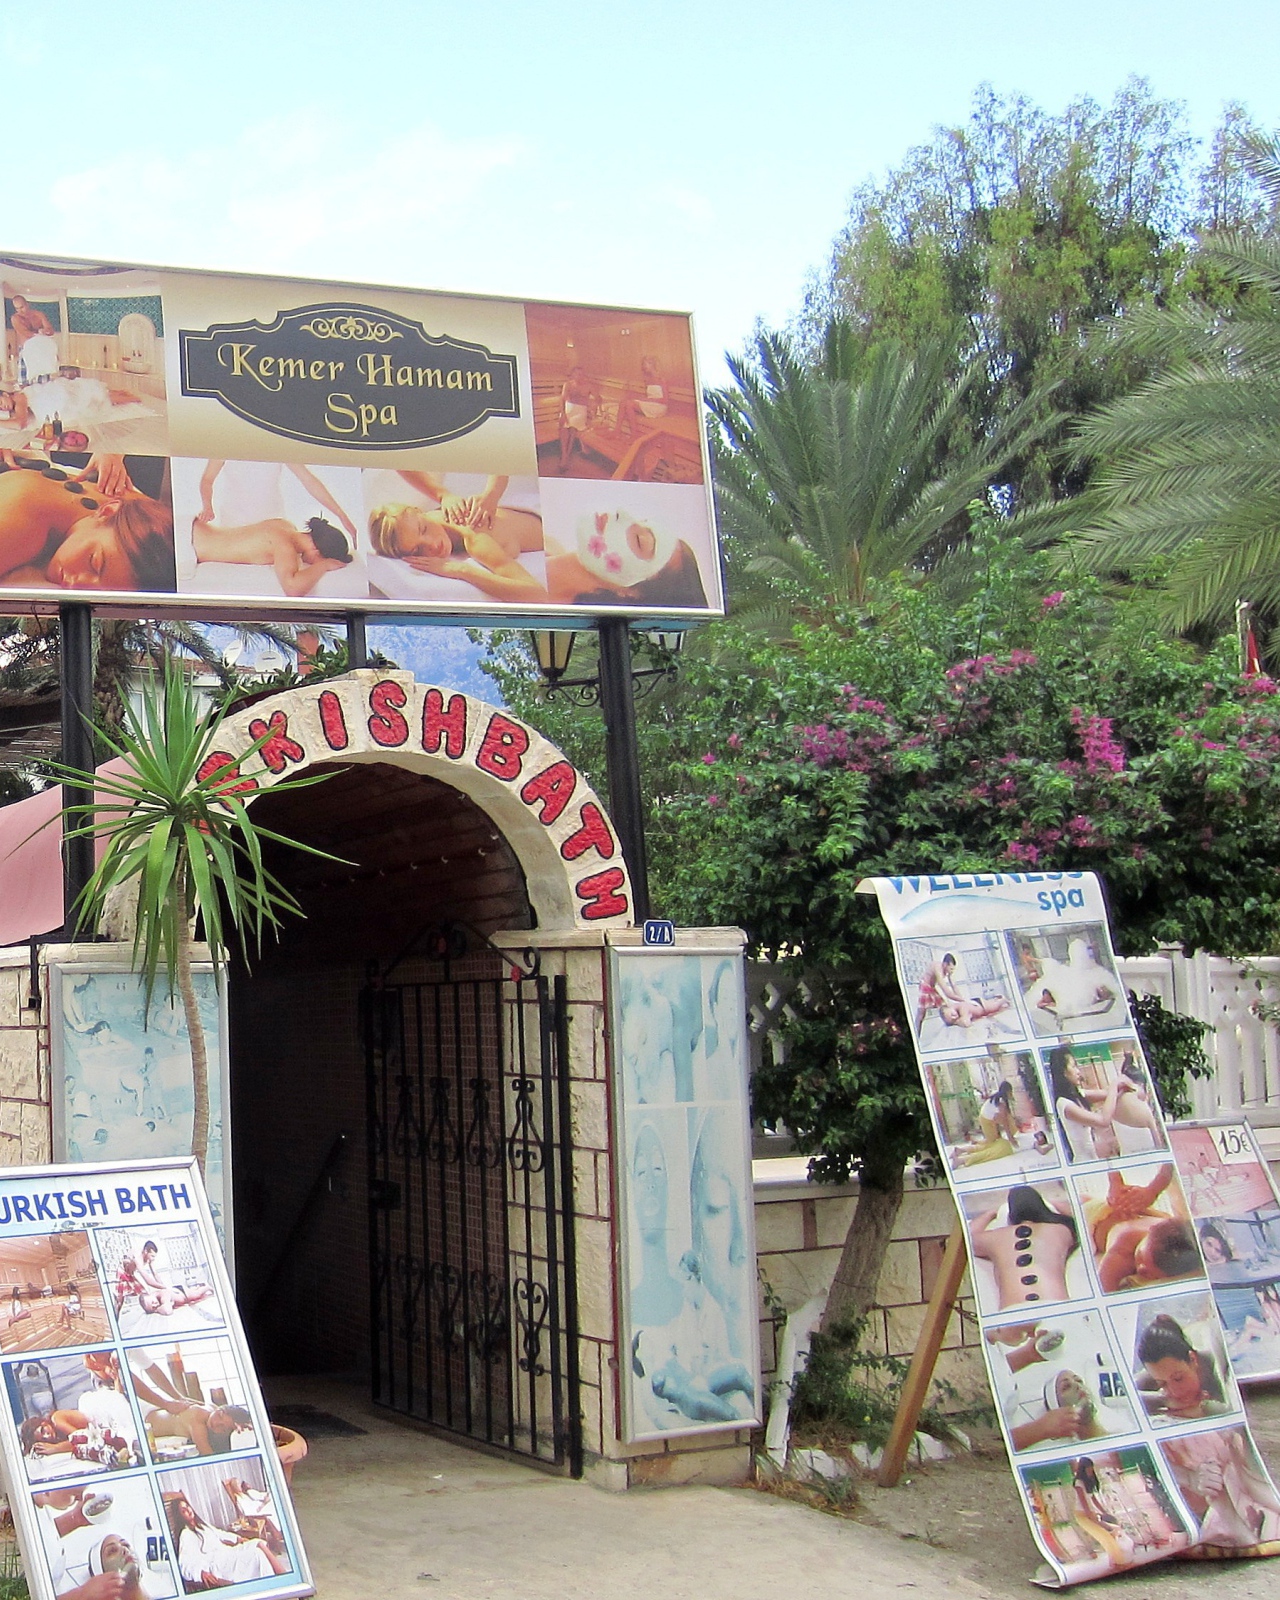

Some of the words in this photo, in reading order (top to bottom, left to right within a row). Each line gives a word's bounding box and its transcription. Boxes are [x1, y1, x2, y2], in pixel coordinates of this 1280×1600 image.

[217, 342, 345, 392] Kemer
[356, 353, 494, 391] Hamam
[324, 392, 399, 437] Spa
[887, 872, 1083, 894] WELLN
[1037, 888, 1085, 917] spa
[649, 925, 671, 943] 2/A
[114, 1183, 192, 1214] BATH
